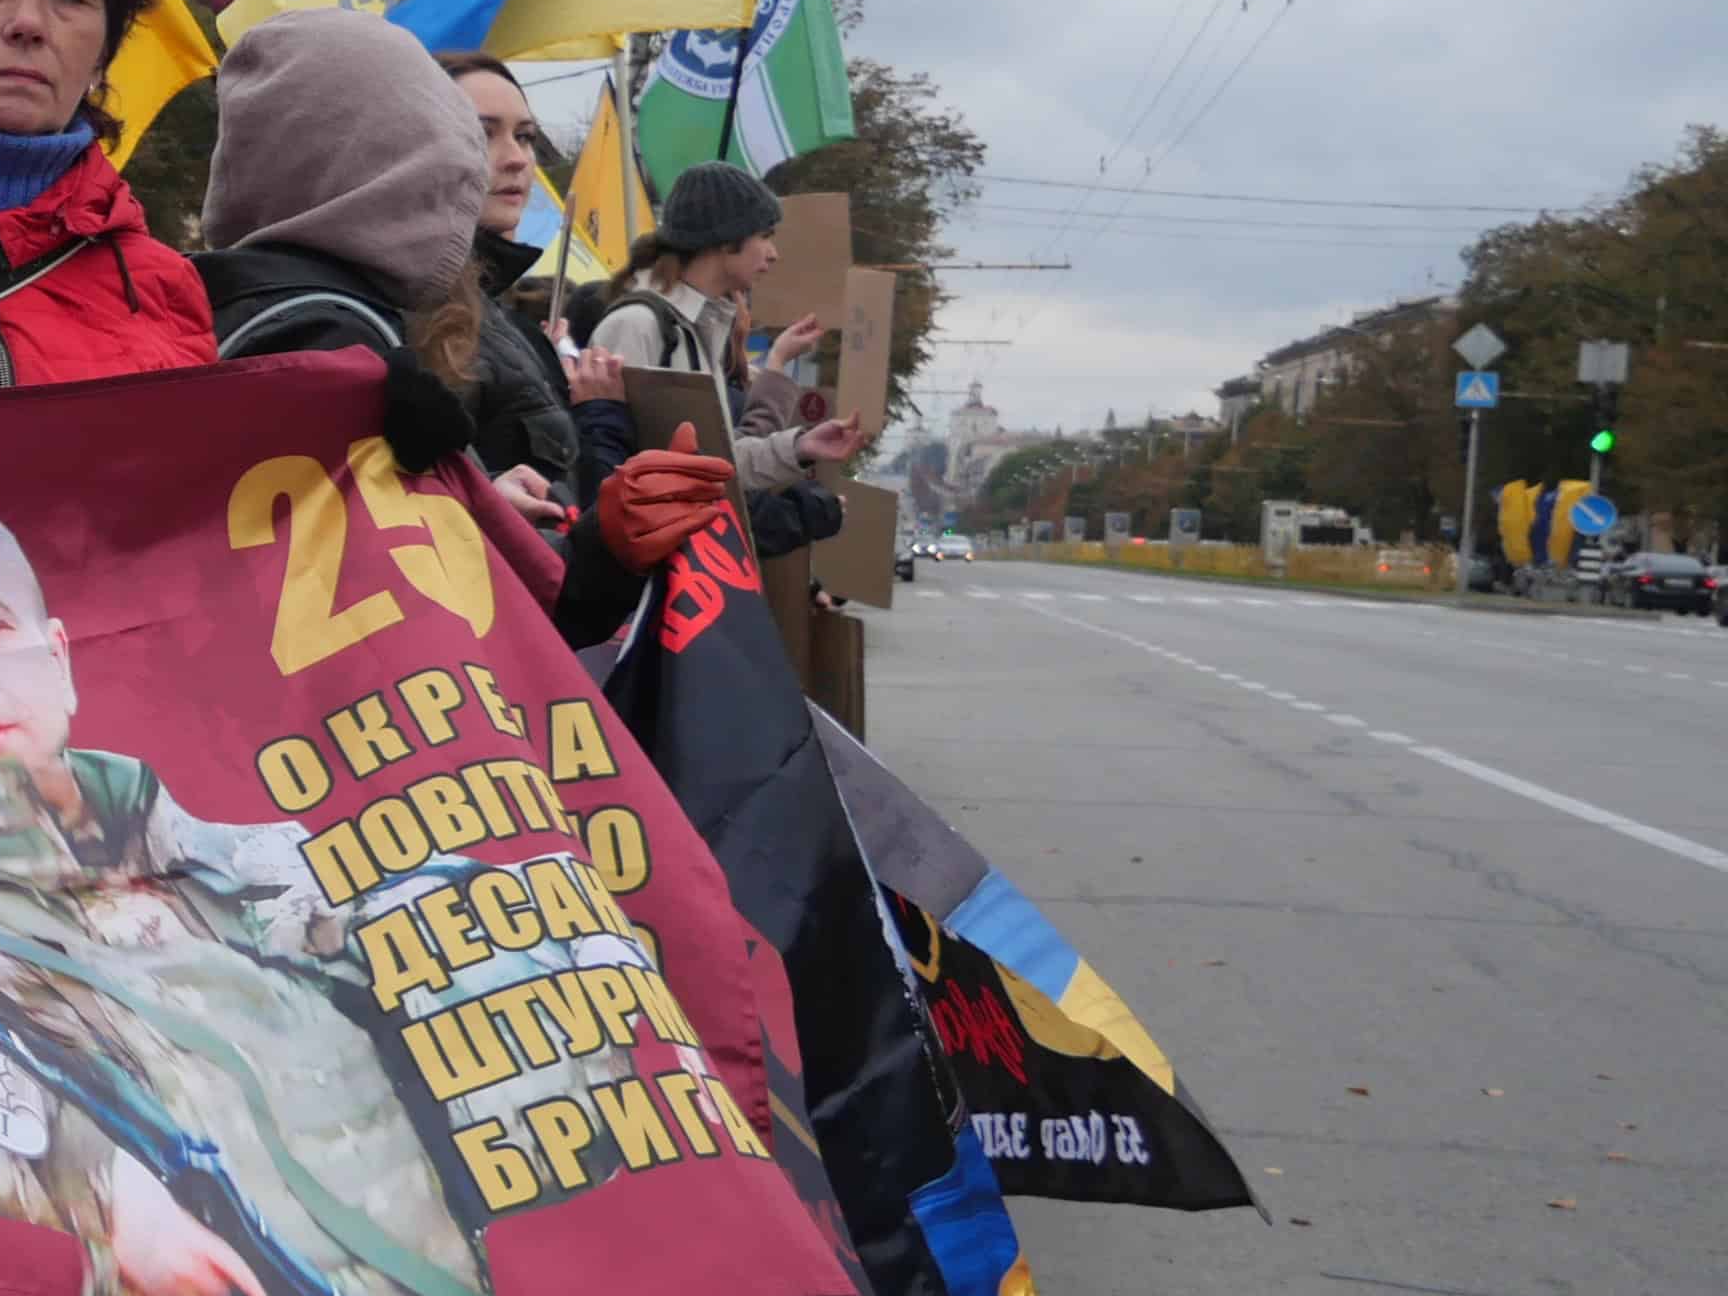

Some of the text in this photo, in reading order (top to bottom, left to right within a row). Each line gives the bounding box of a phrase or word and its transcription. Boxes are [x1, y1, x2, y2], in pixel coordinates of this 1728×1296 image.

[227, 436, 495, 677] 25
[256, 662, 619, 813] ОКРЕА
[400, 962, 701, 1103] ШТУРМ
[451, 1071, 773, 1215] БРИГА
